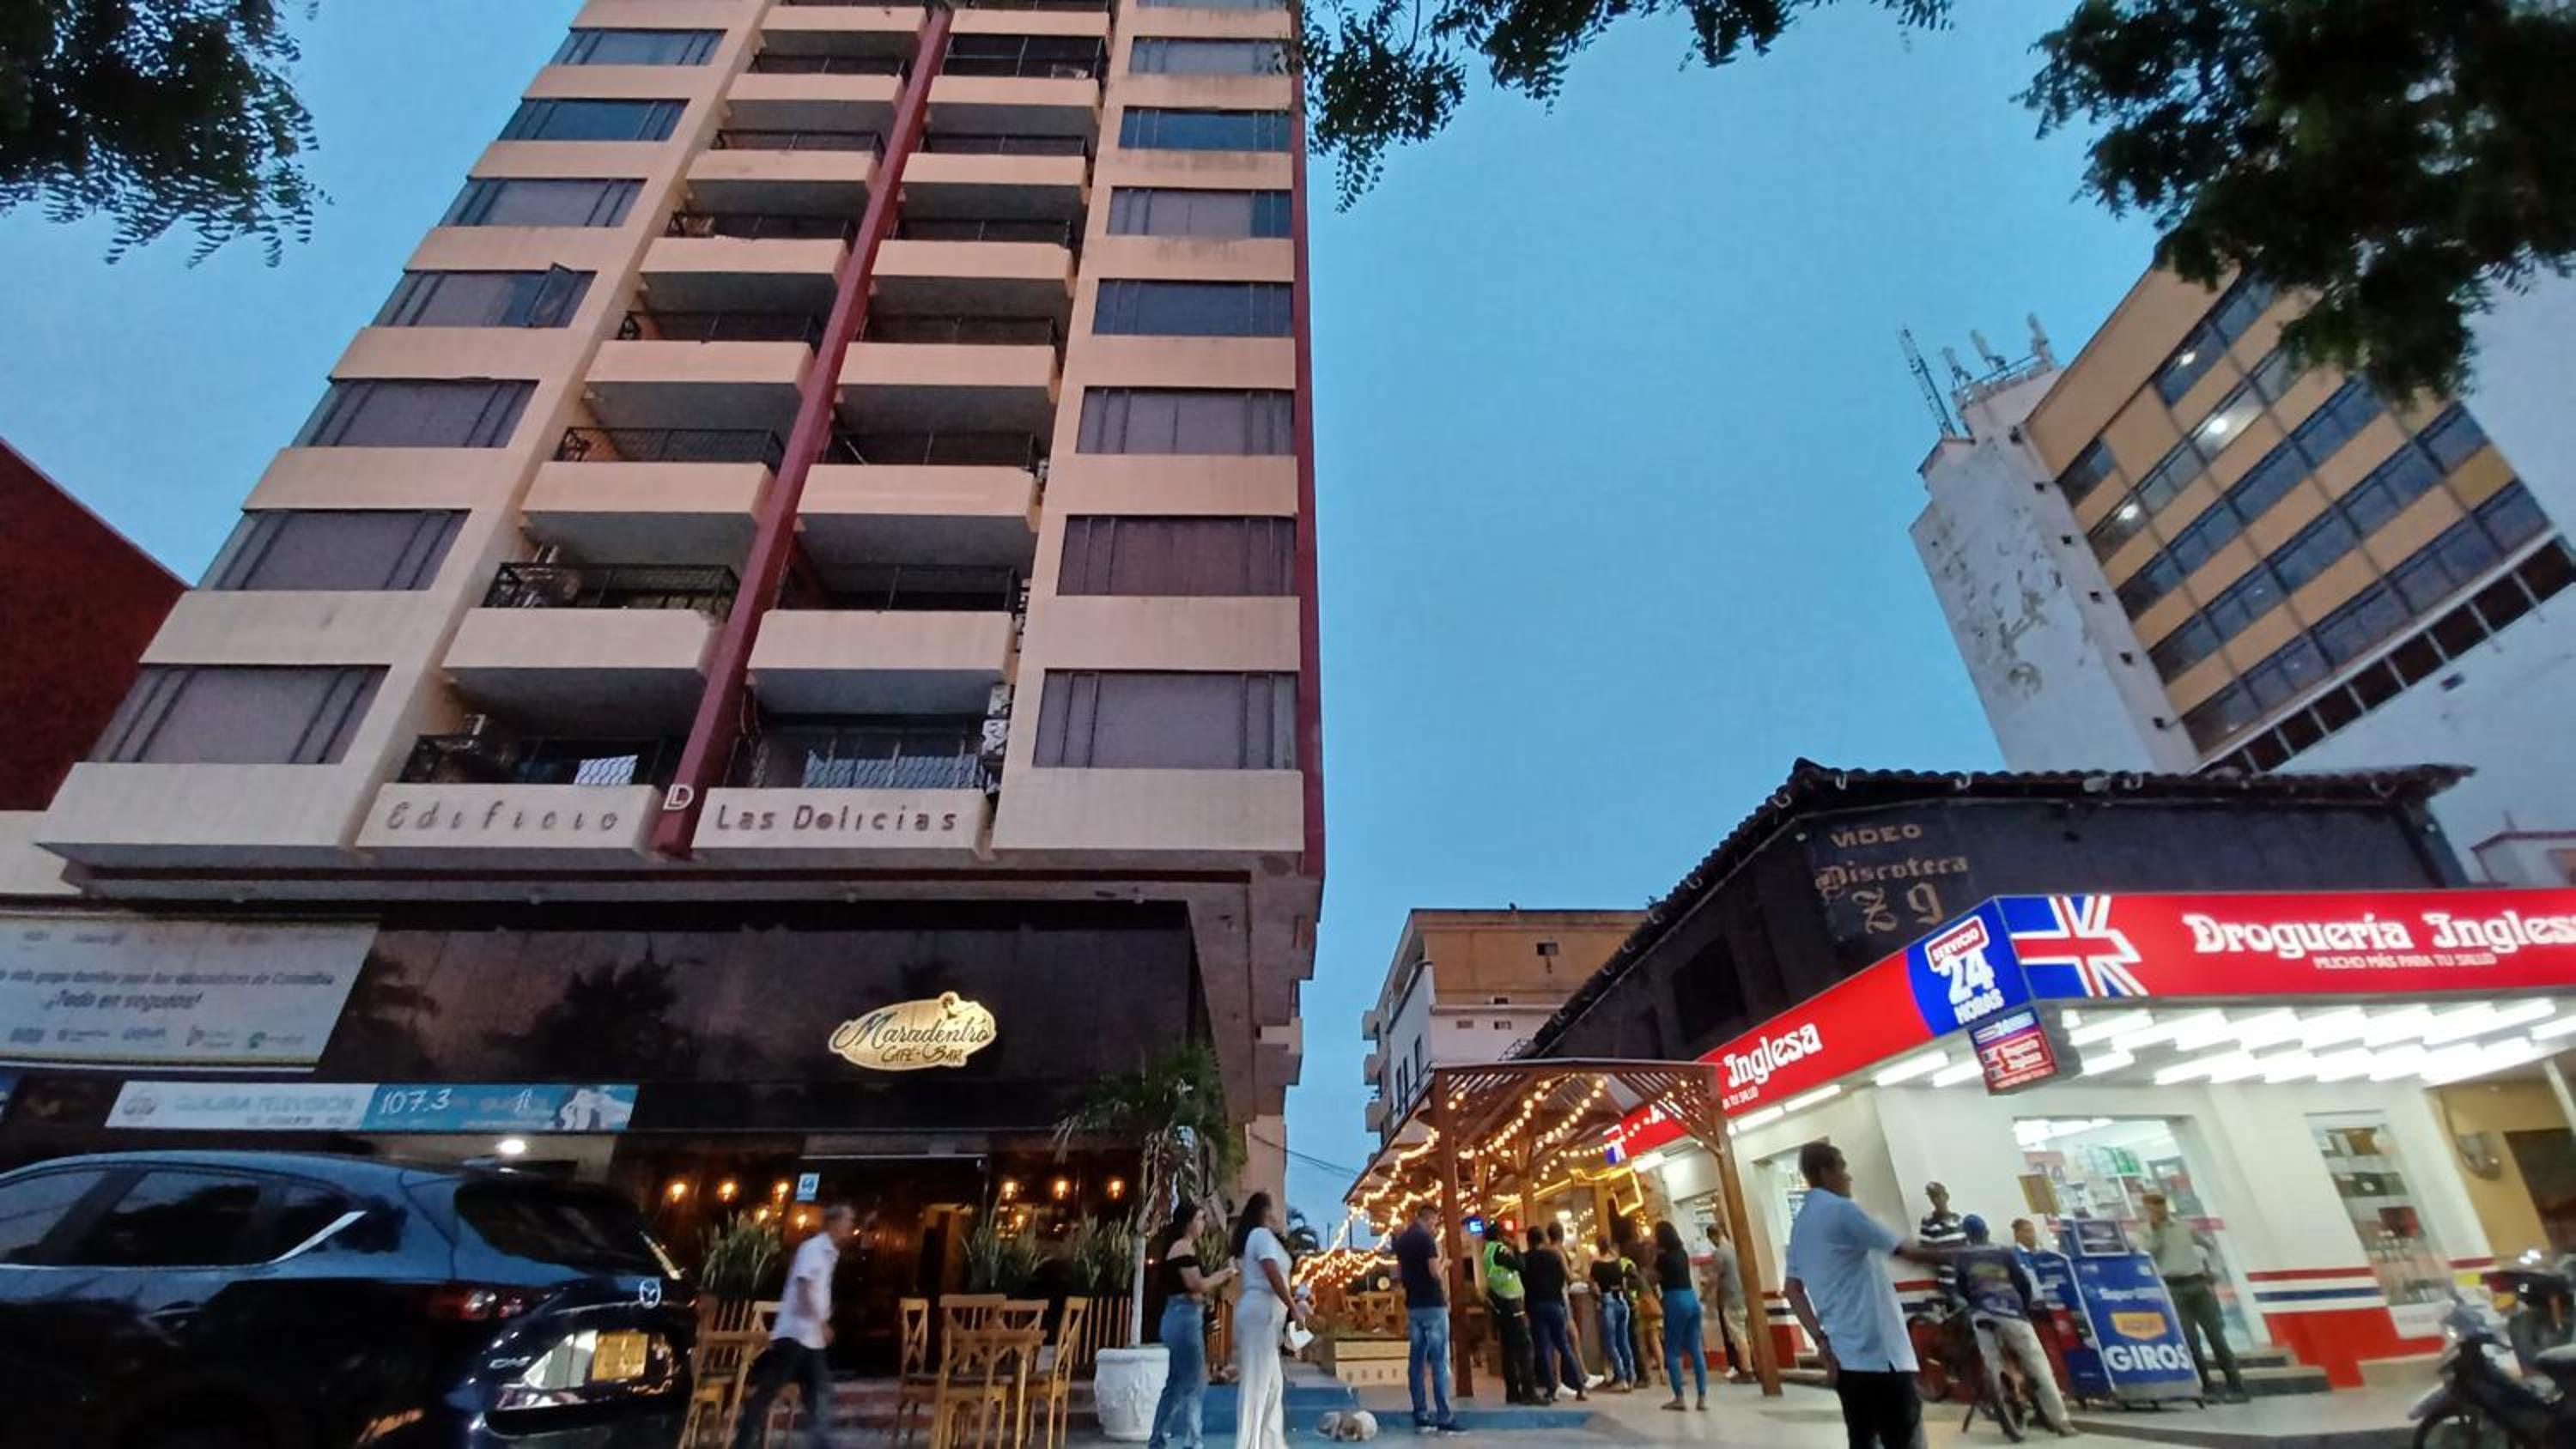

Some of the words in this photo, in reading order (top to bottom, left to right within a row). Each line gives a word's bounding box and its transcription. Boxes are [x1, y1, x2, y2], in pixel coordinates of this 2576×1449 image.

[387, 801, 618, 830] Edificio
[716, 804, 775, 830] Las
[793, 804, 957, 831] Delicias
[1831, 824, 1923, 848] VIDEO
[2421, 909, 2576, 954] Ingles
[2312, 955, 2366, 969] MUCHO
[1941, 949, 1996, 1005] 24
[1953, 989, 2005, 1024] HORAS
[1722, 1022, 1823, 1088] Inglesa
[379, 1088, 453, 1114] 107.3
[2105, 1343, 2191, 1372] GIROS
